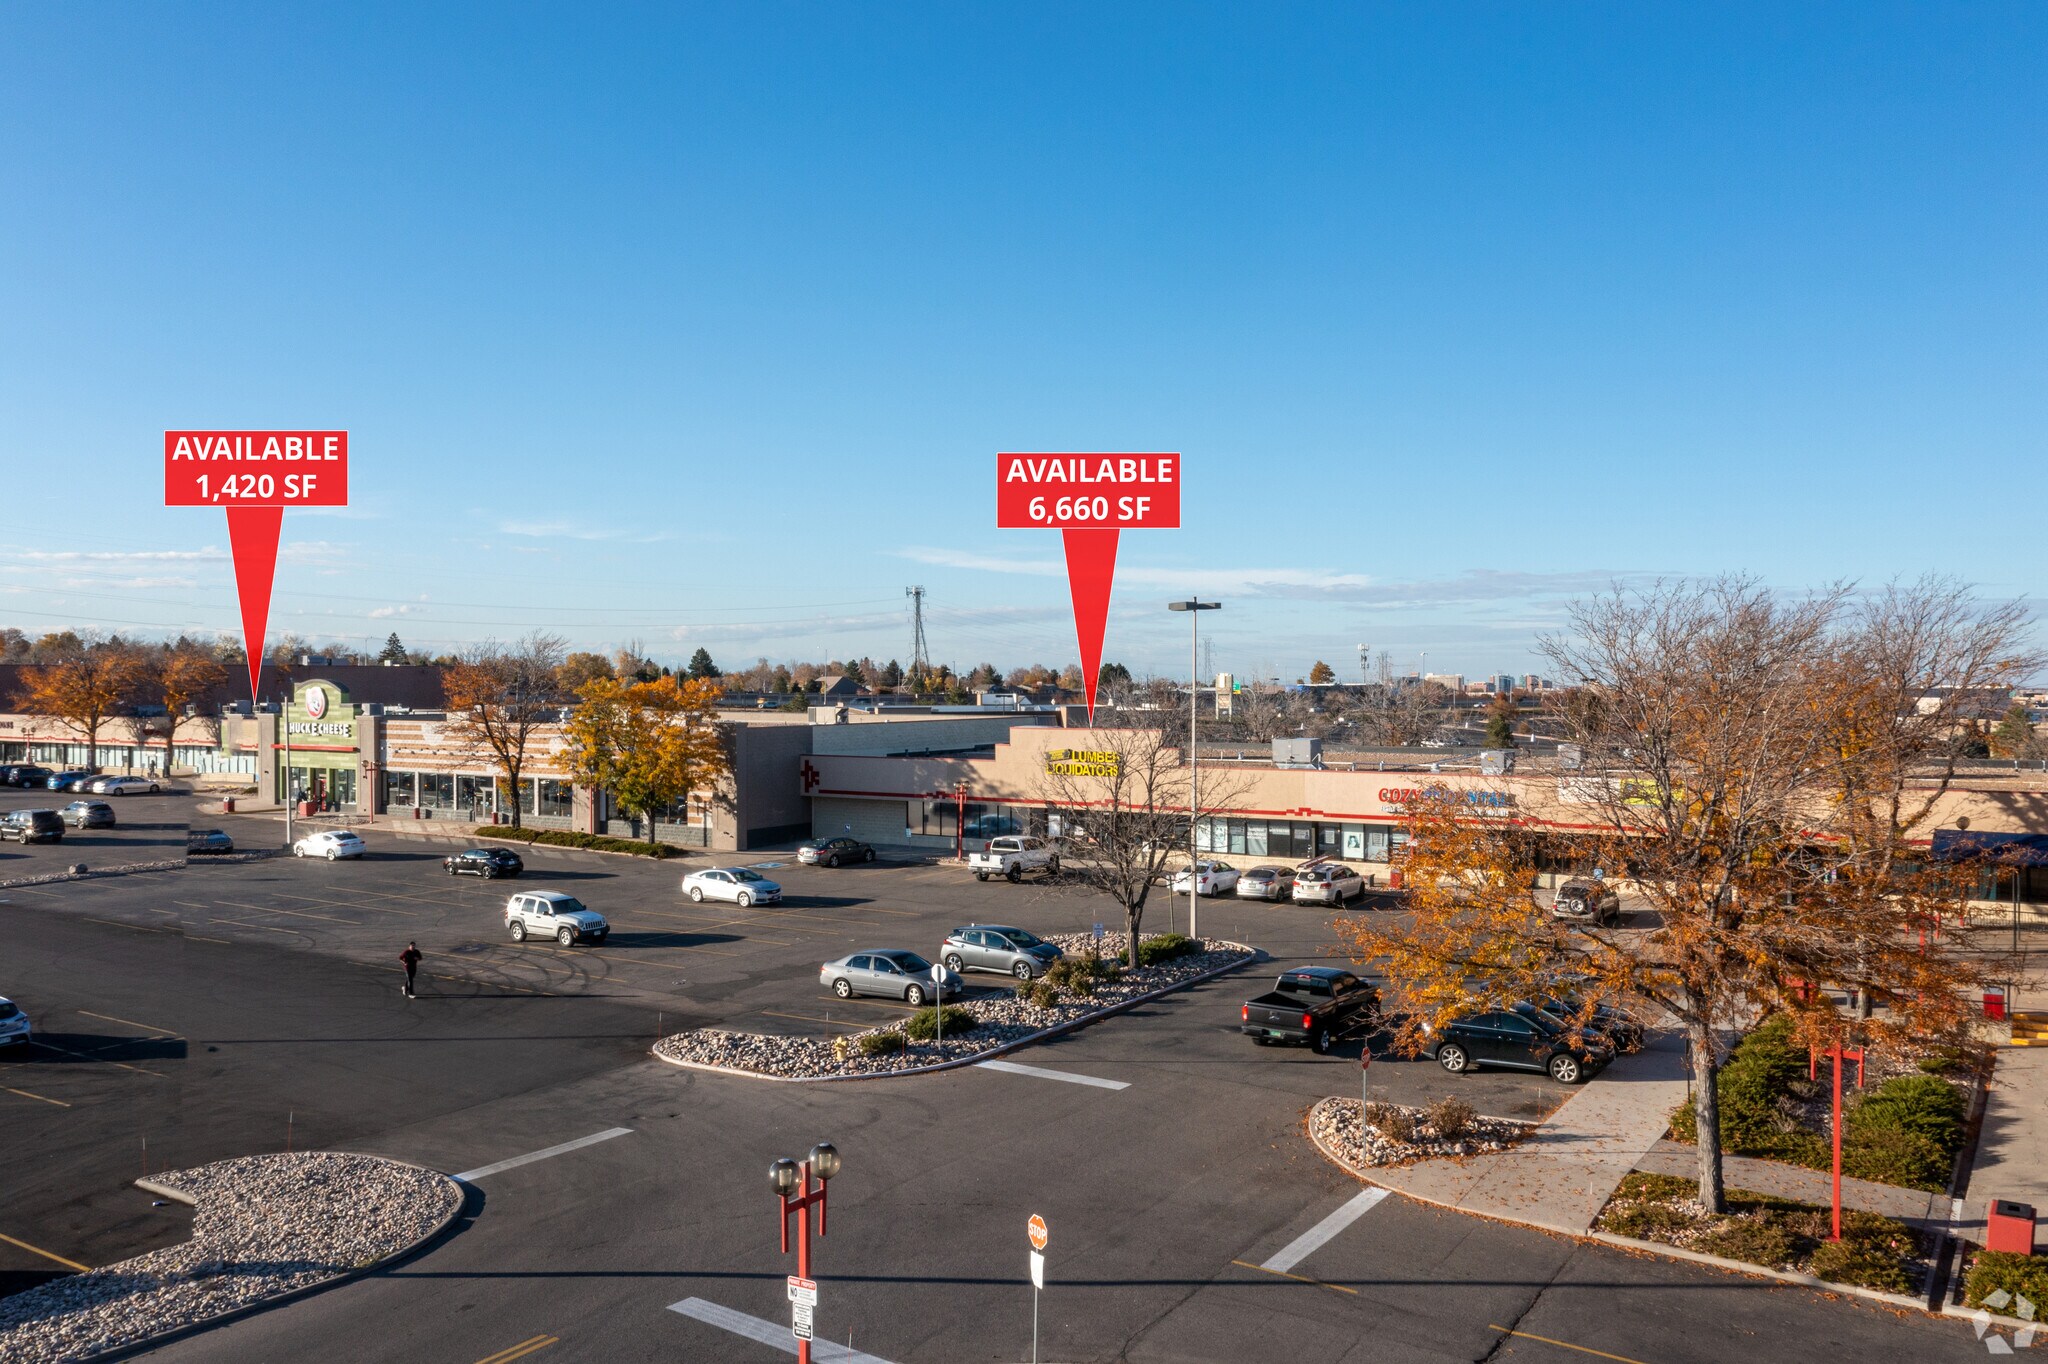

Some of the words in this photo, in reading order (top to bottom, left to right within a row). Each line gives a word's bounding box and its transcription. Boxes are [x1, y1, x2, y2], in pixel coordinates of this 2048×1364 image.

[284, 722, 311, 734] HUCK
[318, 723, 349, 737] CHEESE
[1378, 788, 1422, 802] COZY
[1443, 790, 1506, 807] DNTAL
[1029, 1223, 1046, 1240] STOP
